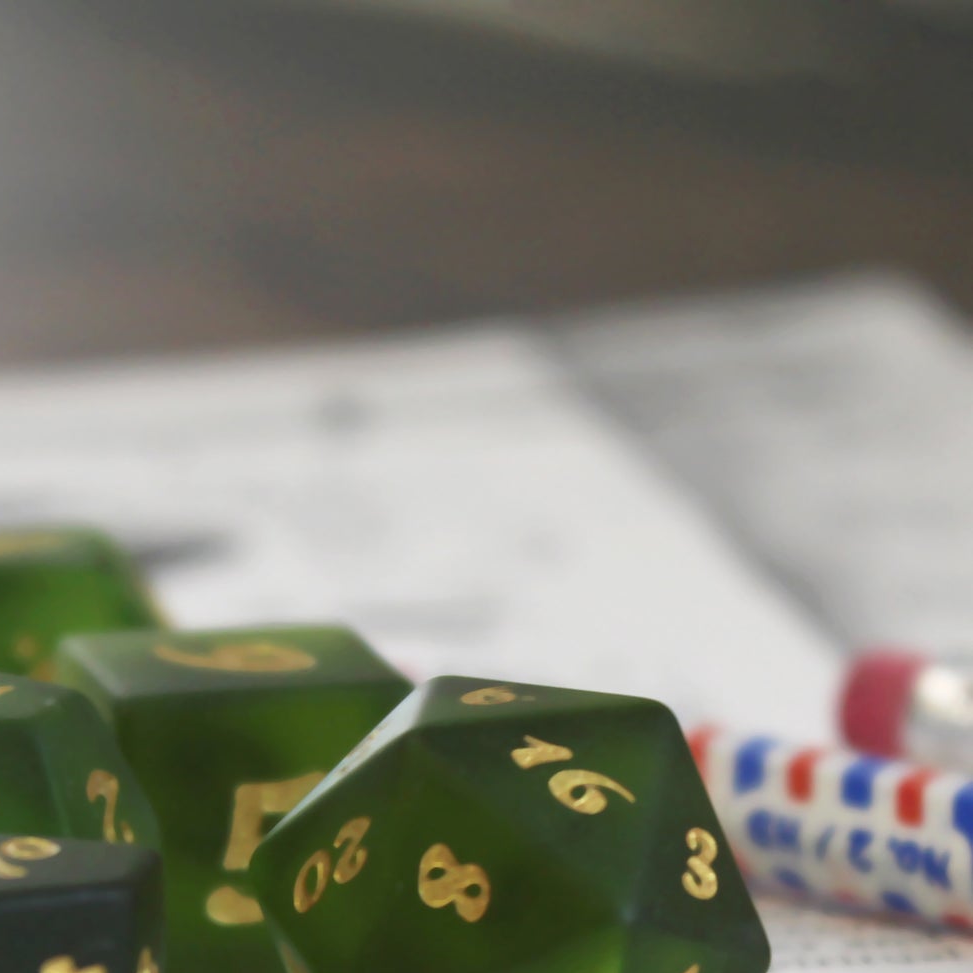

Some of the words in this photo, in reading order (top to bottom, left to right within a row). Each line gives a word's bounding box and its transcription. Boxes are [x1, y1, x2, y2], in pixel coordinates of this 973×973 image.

[293, 815, 372, 914] 20
[417, 842, 492, 923] 8
[681, 826, 719, 900] 3
